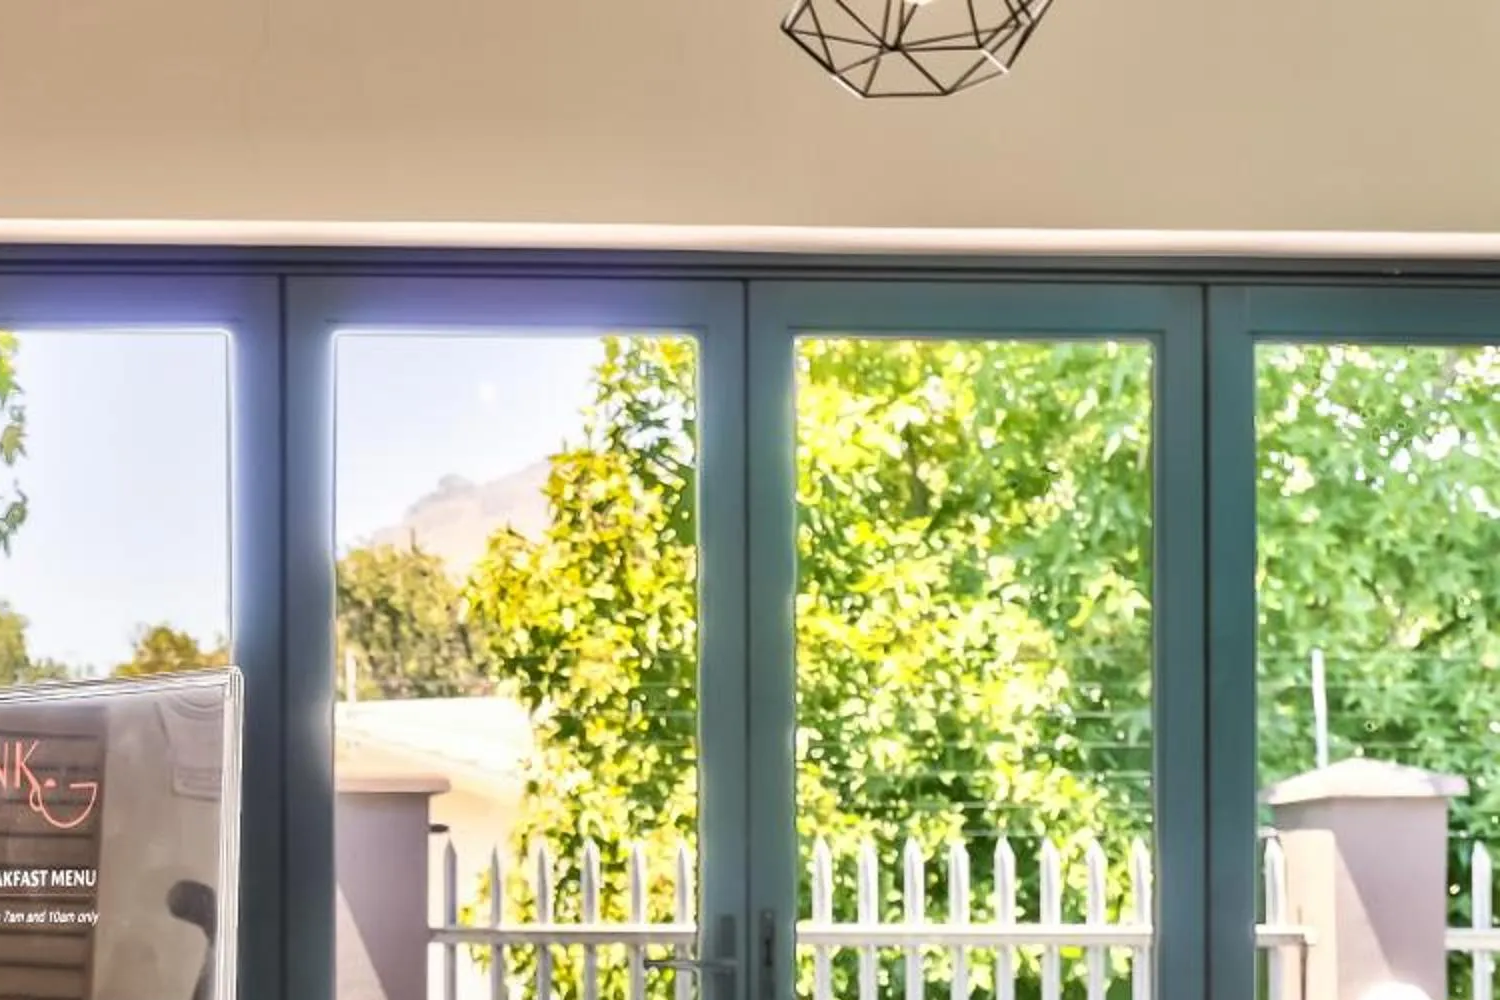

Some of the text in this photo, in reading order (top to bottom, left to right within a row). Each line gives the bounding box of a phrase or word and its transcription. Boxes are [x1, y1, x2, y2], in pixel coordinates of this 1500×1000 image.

[51, 869, 96, 886] MENU
[4, 911, 24, 923] 7am
[26, 910, 45, 923] and
[49, 910, 74, 923] 10am
[77, 911, 99, 926] only
